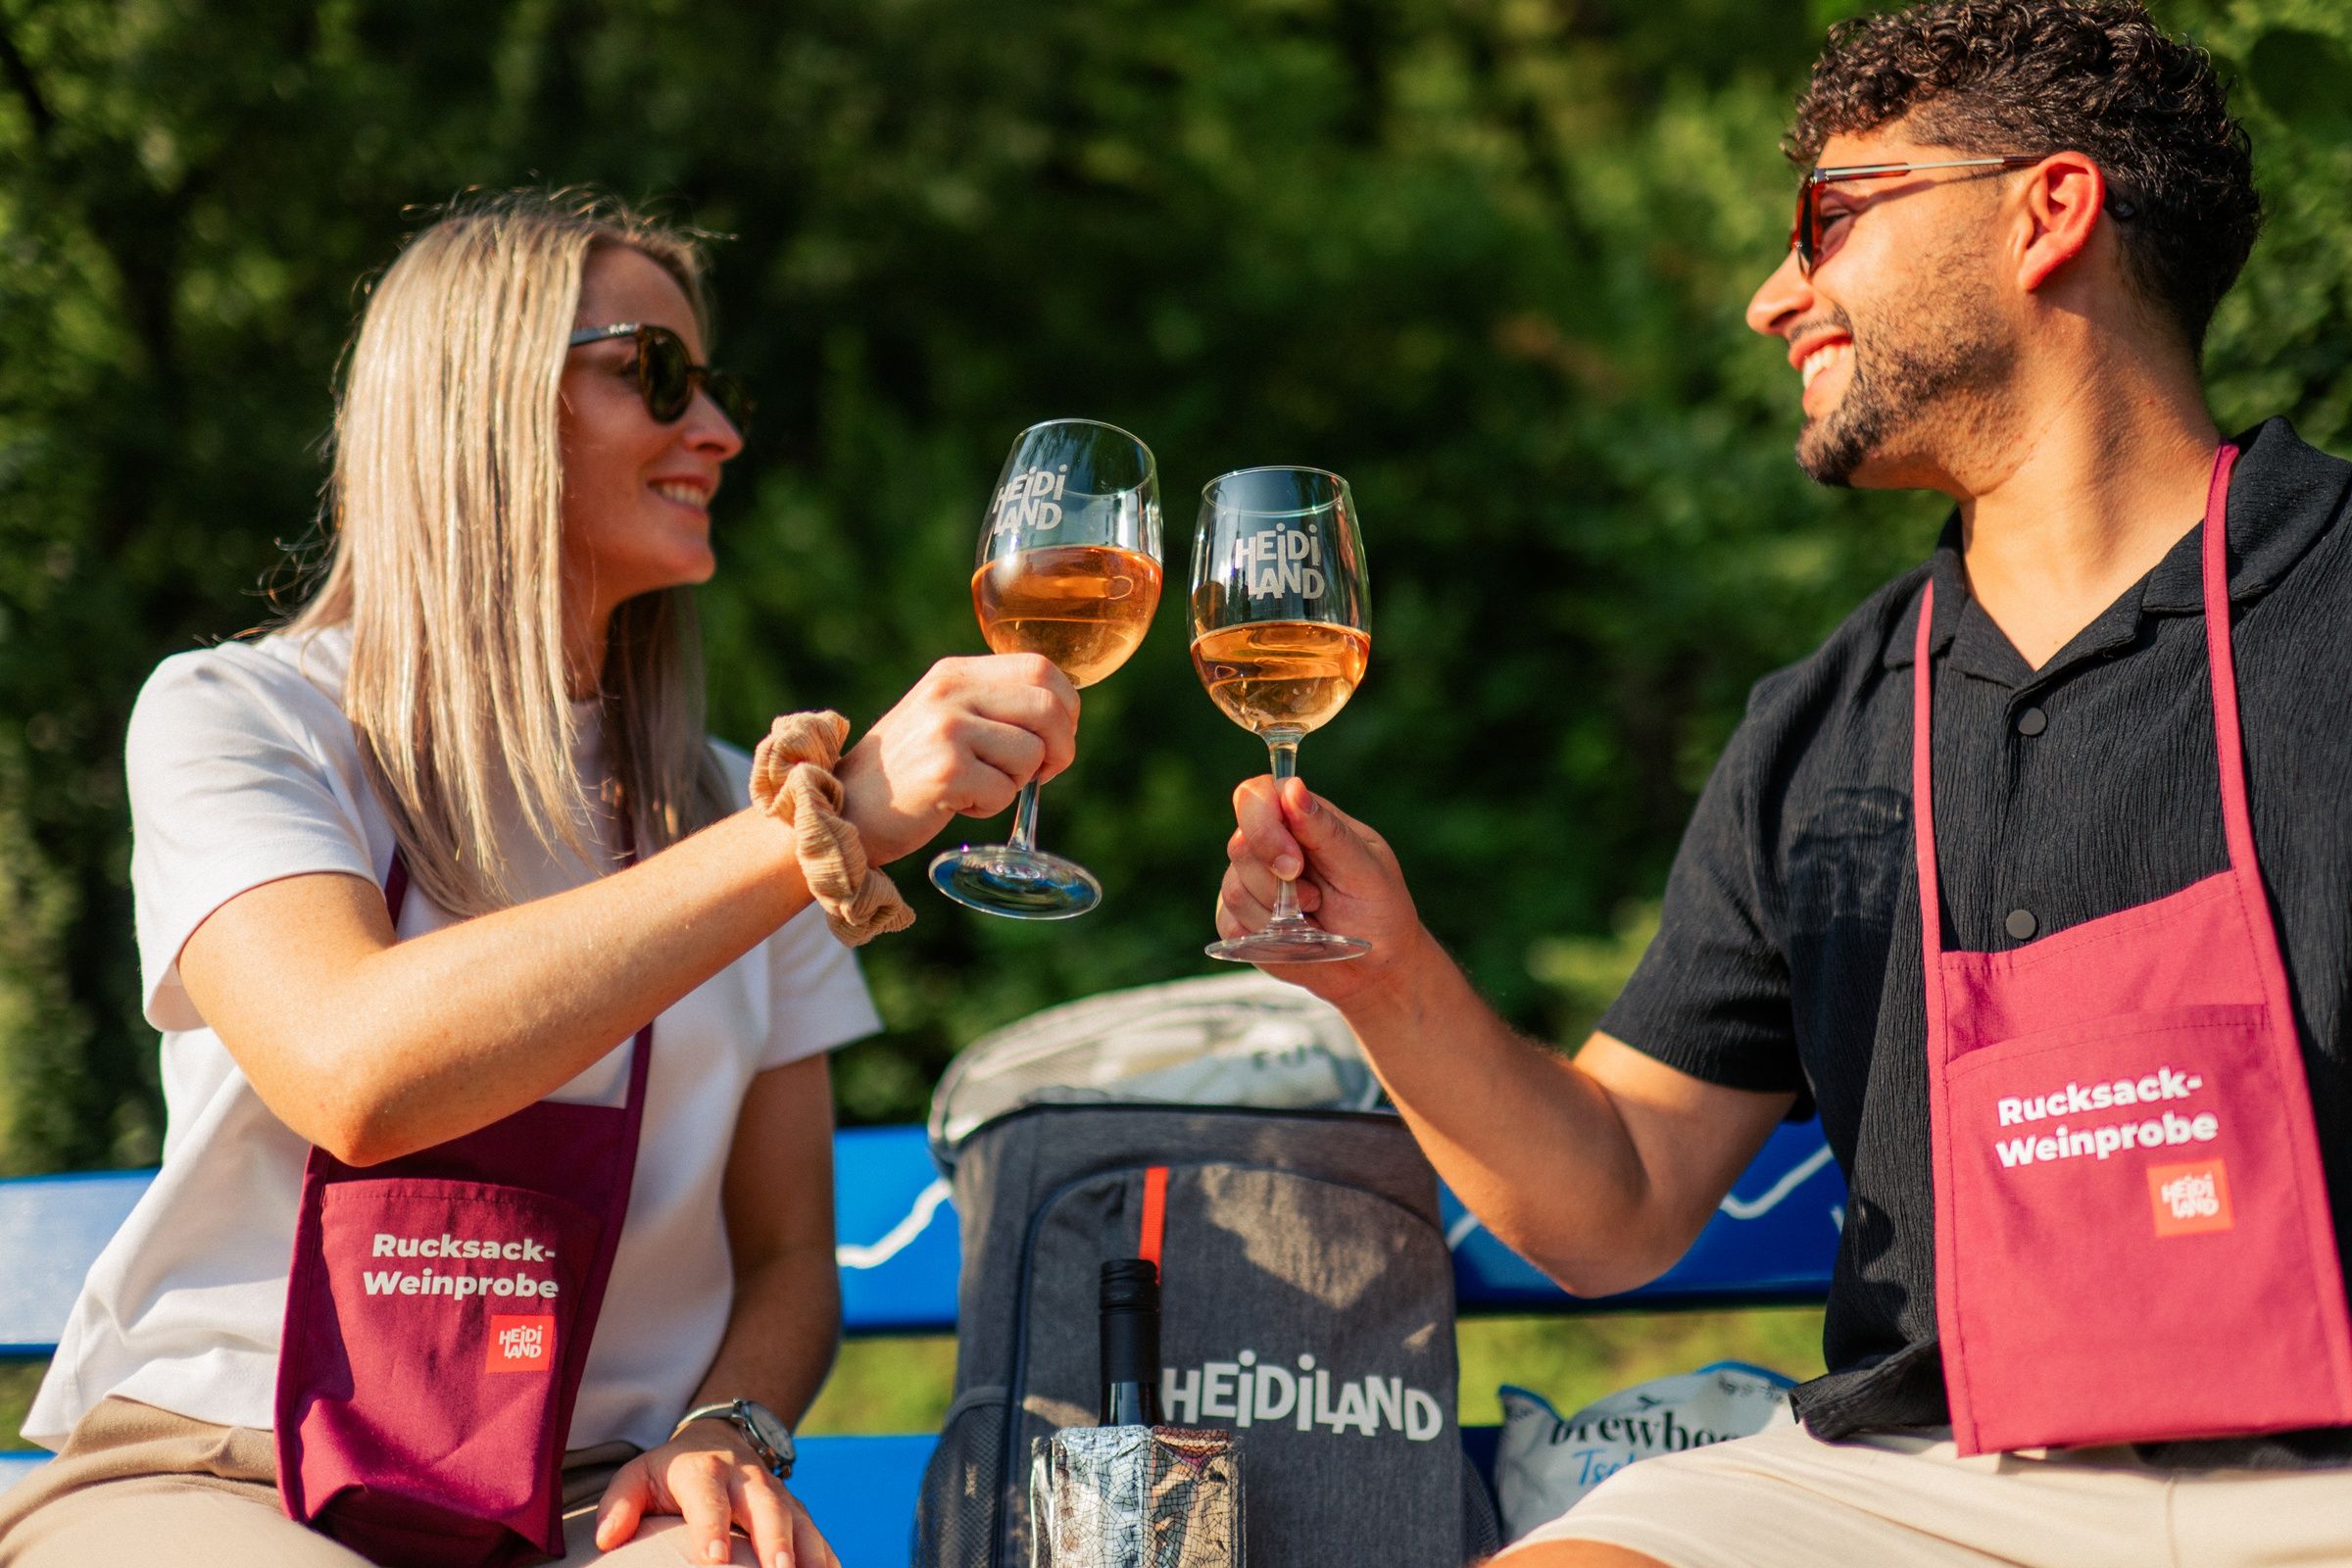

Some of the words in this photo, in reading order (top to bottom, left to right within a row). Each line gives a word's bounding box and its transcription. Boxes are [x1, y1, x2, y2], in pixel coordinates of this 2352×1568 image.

[994, 499, 1062, 536] LAND
[1249, 562, 1325, 600] LAND
[1997, 1065, 2202, 1127] Rucksack-
[1995, 1109, 2219, 1168] Weinprobe
[371, 1234, 556, 1262] Rucksack-
[363, 1268, 560, 1299] Weinprobe
[504, 1343, 542, 1359] LAND
